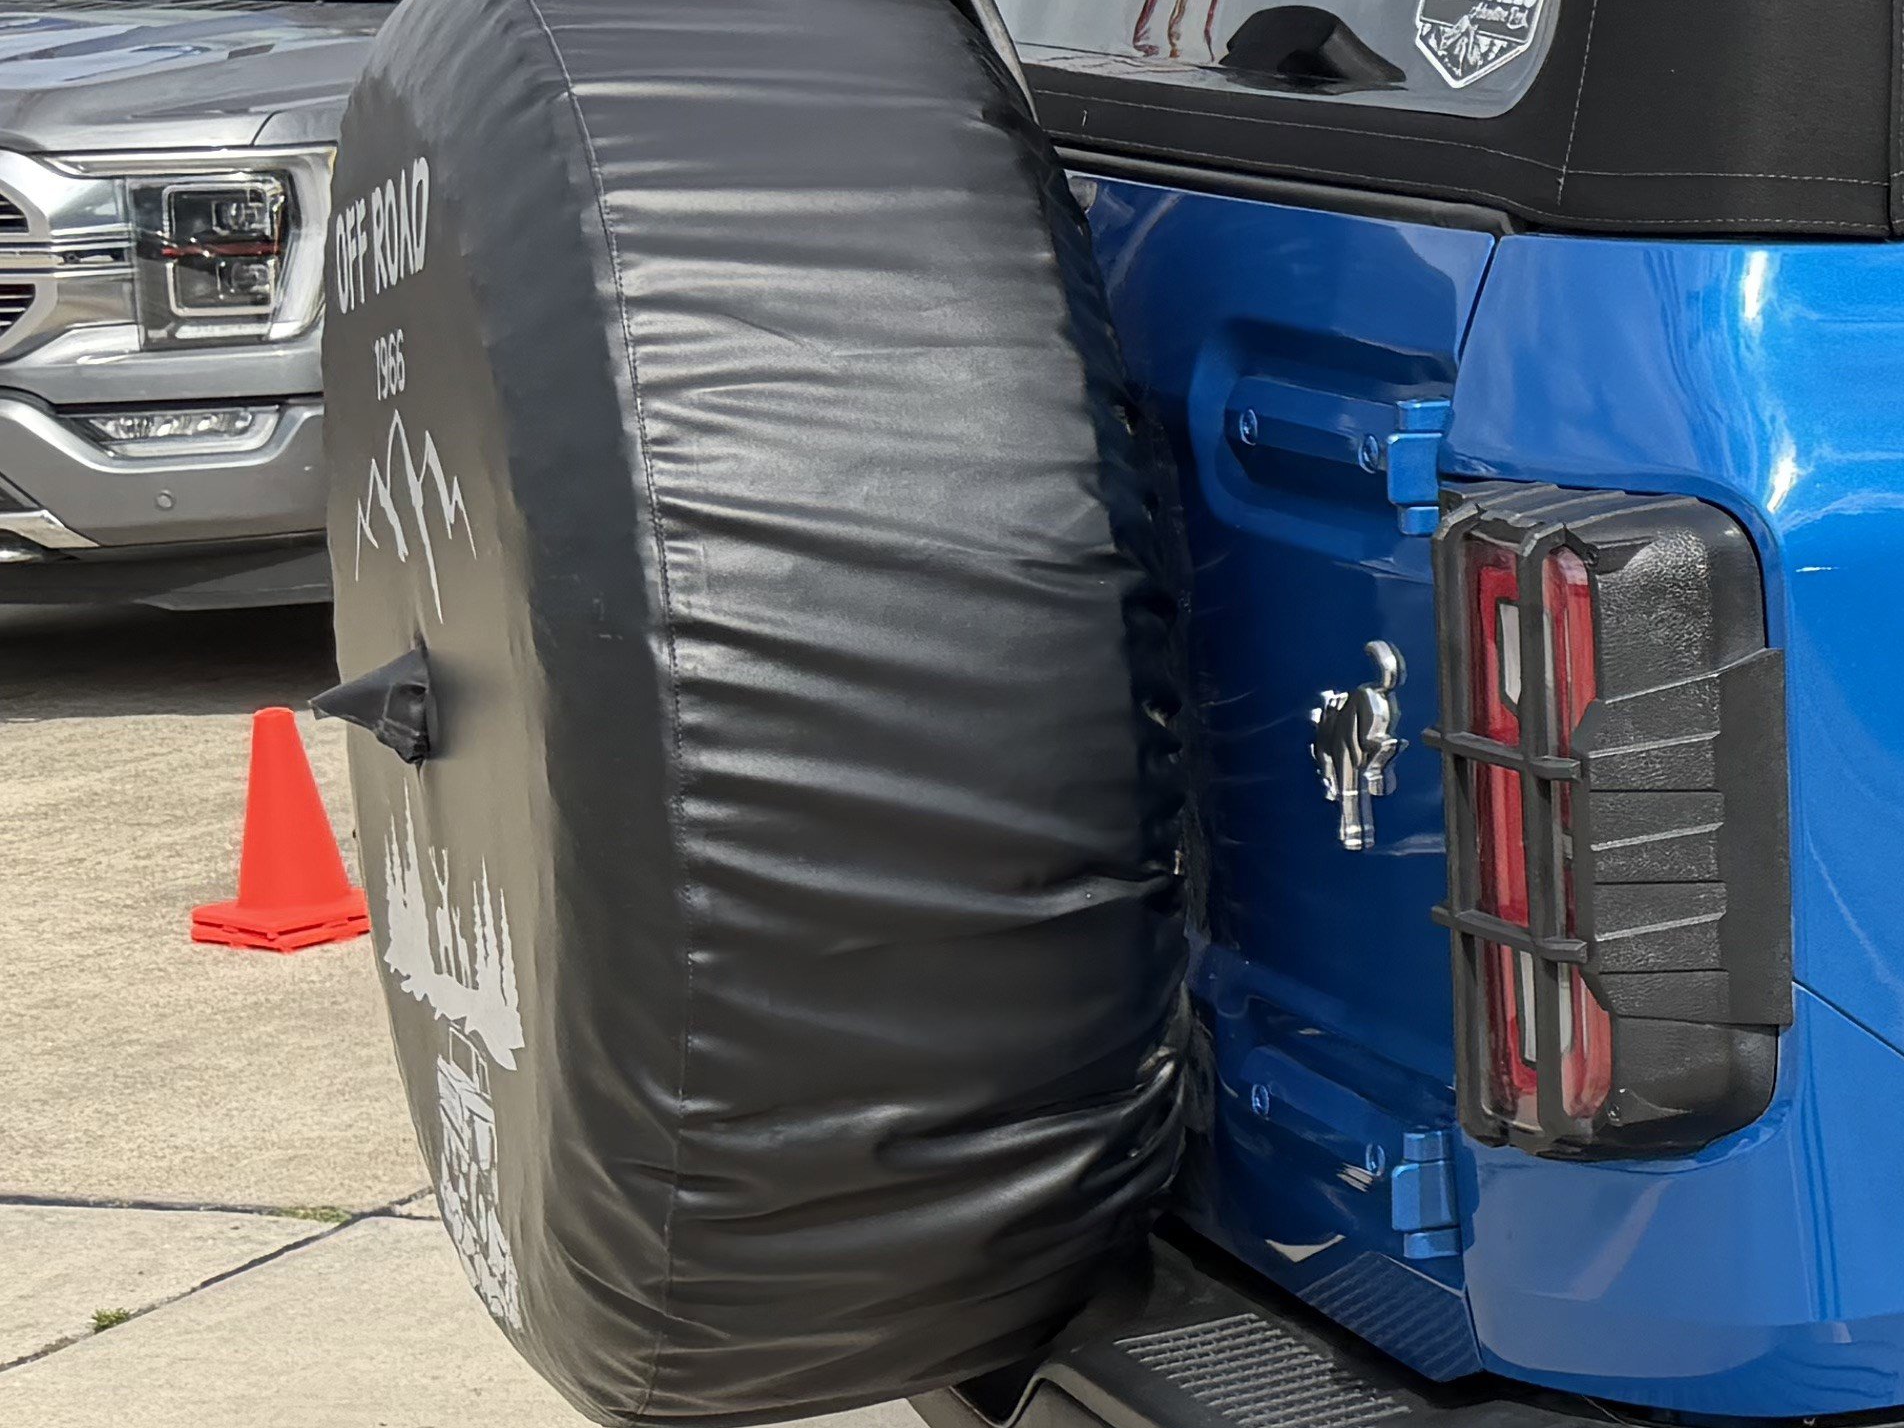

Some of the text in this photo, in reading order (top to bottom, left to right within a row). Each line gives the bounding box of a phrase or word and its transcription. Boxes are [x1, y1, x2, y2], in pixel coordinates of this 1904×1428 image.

[336, 157, 430, 314] OFF ROAD
[374, 328, 406, 401] 1966
